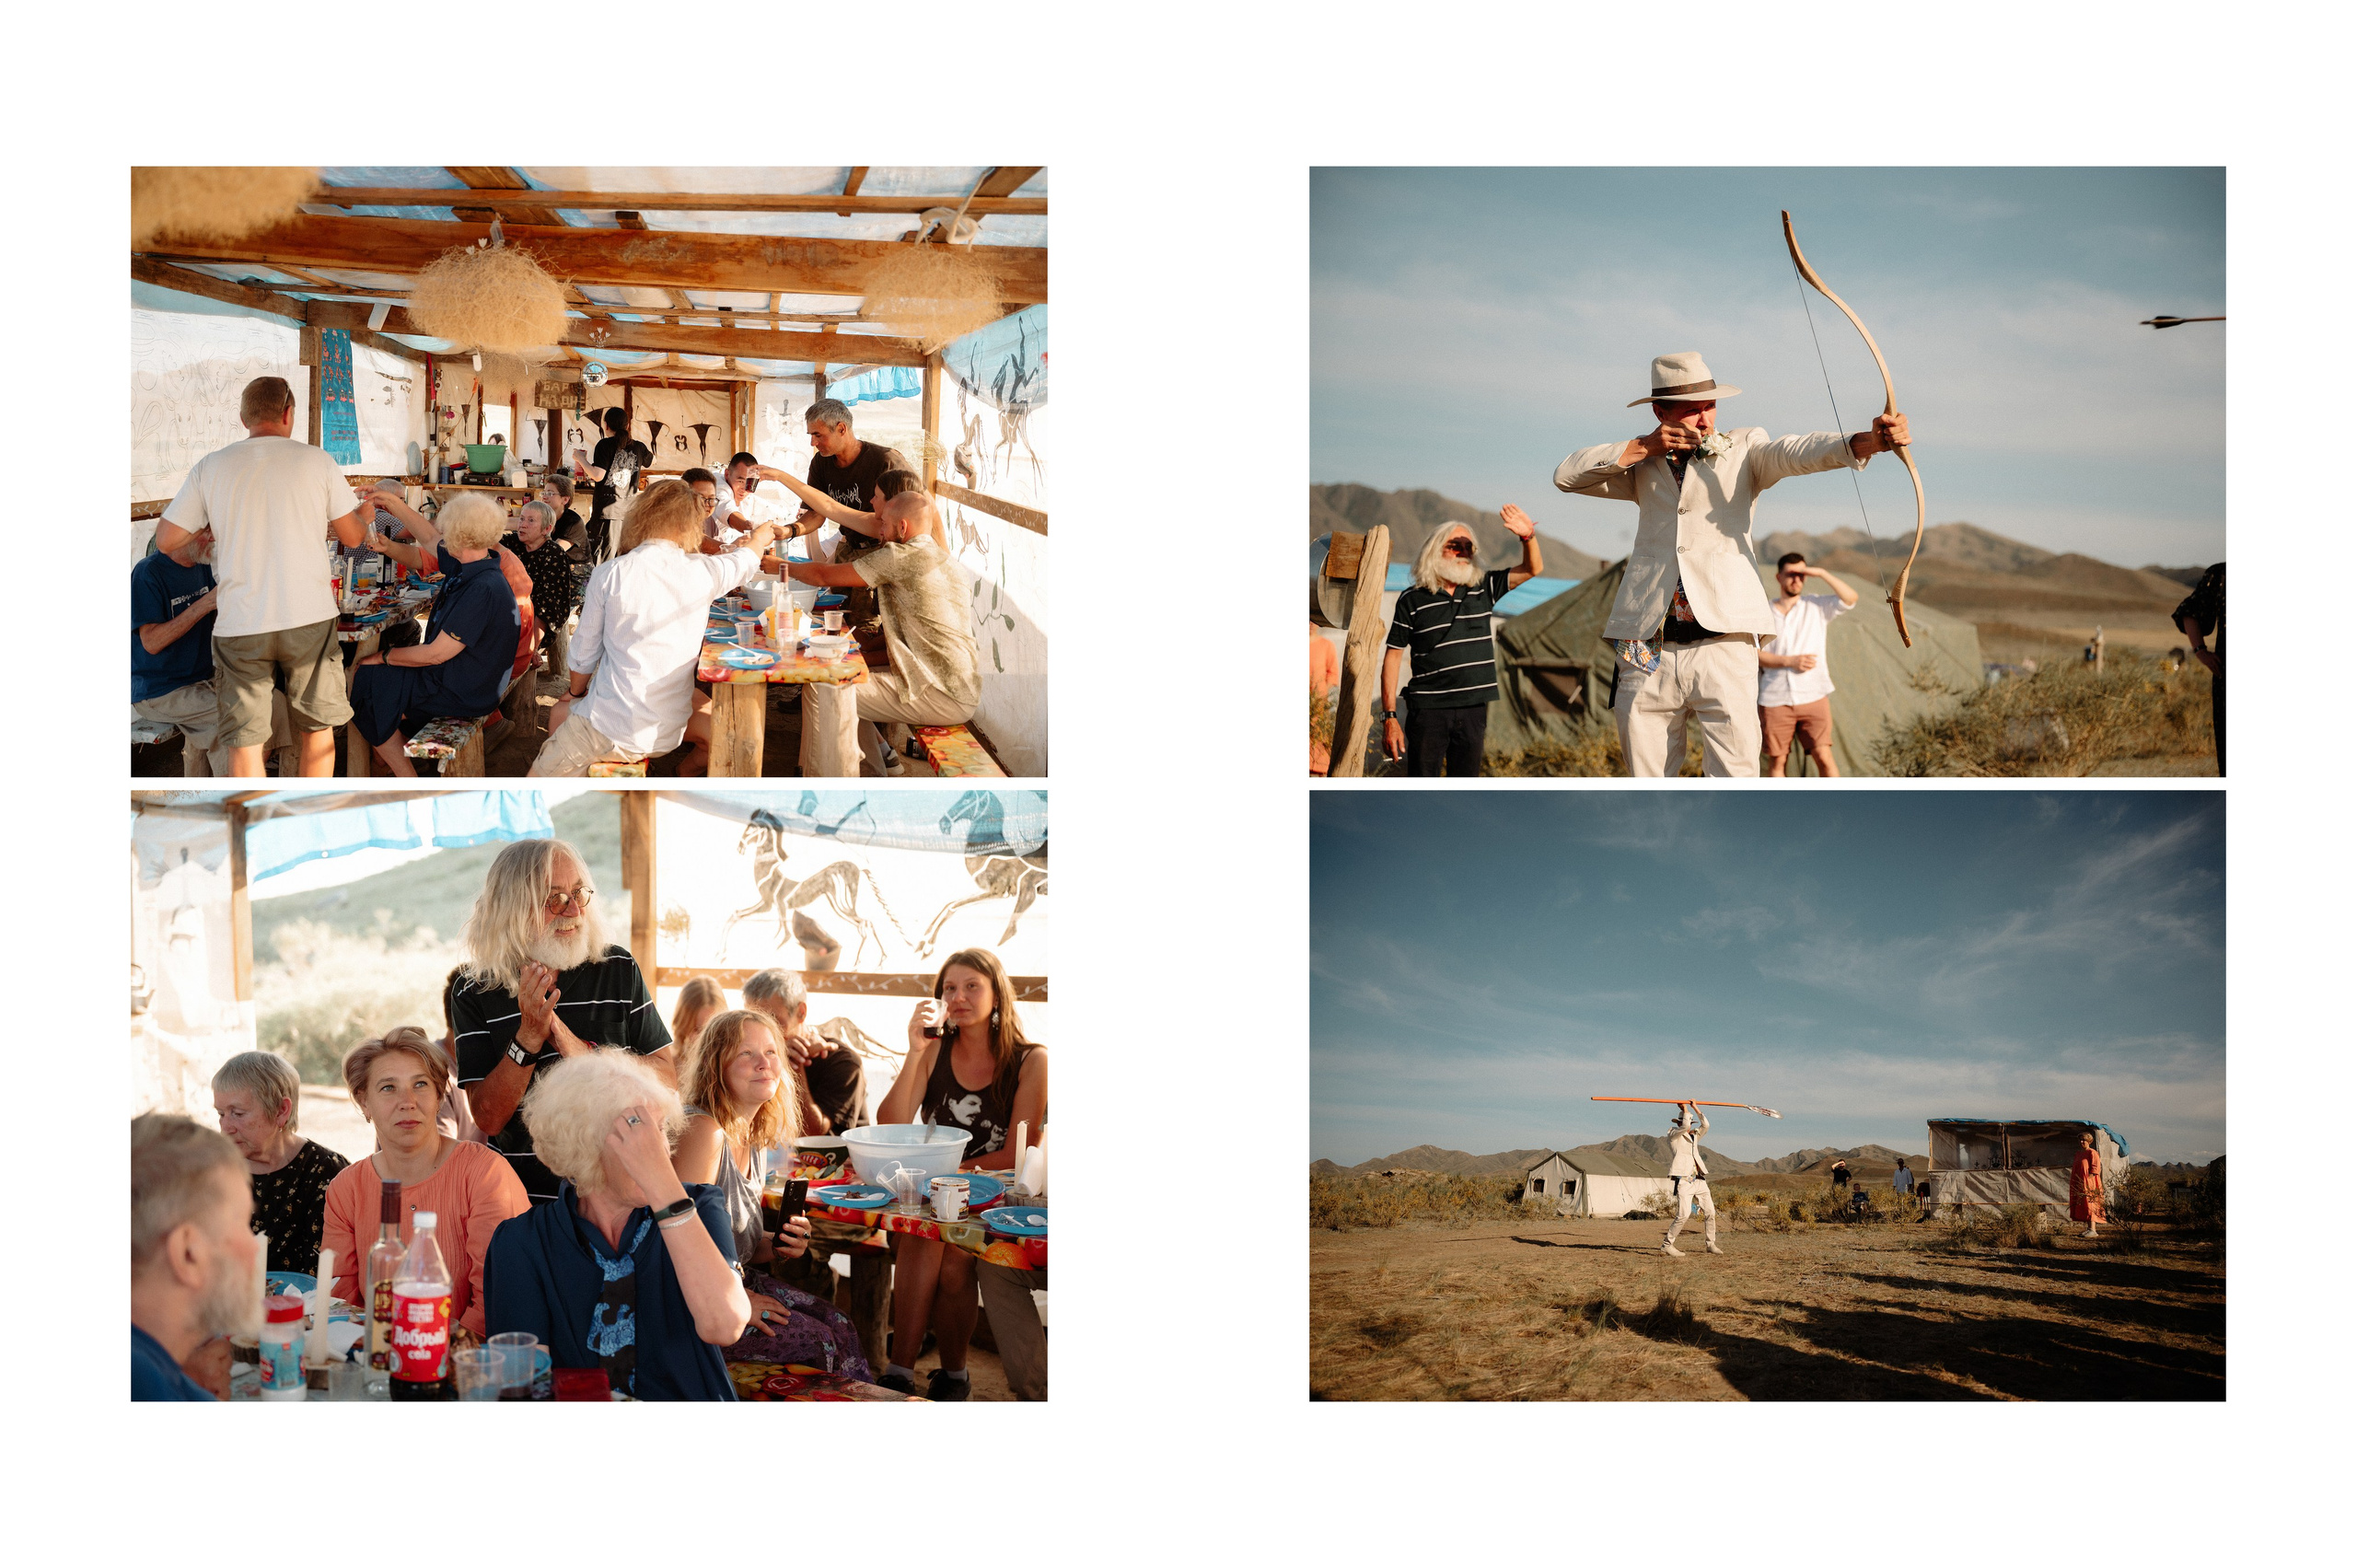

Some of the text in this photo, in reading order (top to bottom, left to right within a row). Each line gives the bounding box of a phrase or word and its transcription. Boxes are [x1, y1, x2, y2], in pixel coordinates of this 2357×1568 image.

[543, 380, 570, 392] БАР
[539, 393, 559, 408] НА
[394, 1325, 447, 1349] Добрый
[407, 1348, 432, 1361] cola
